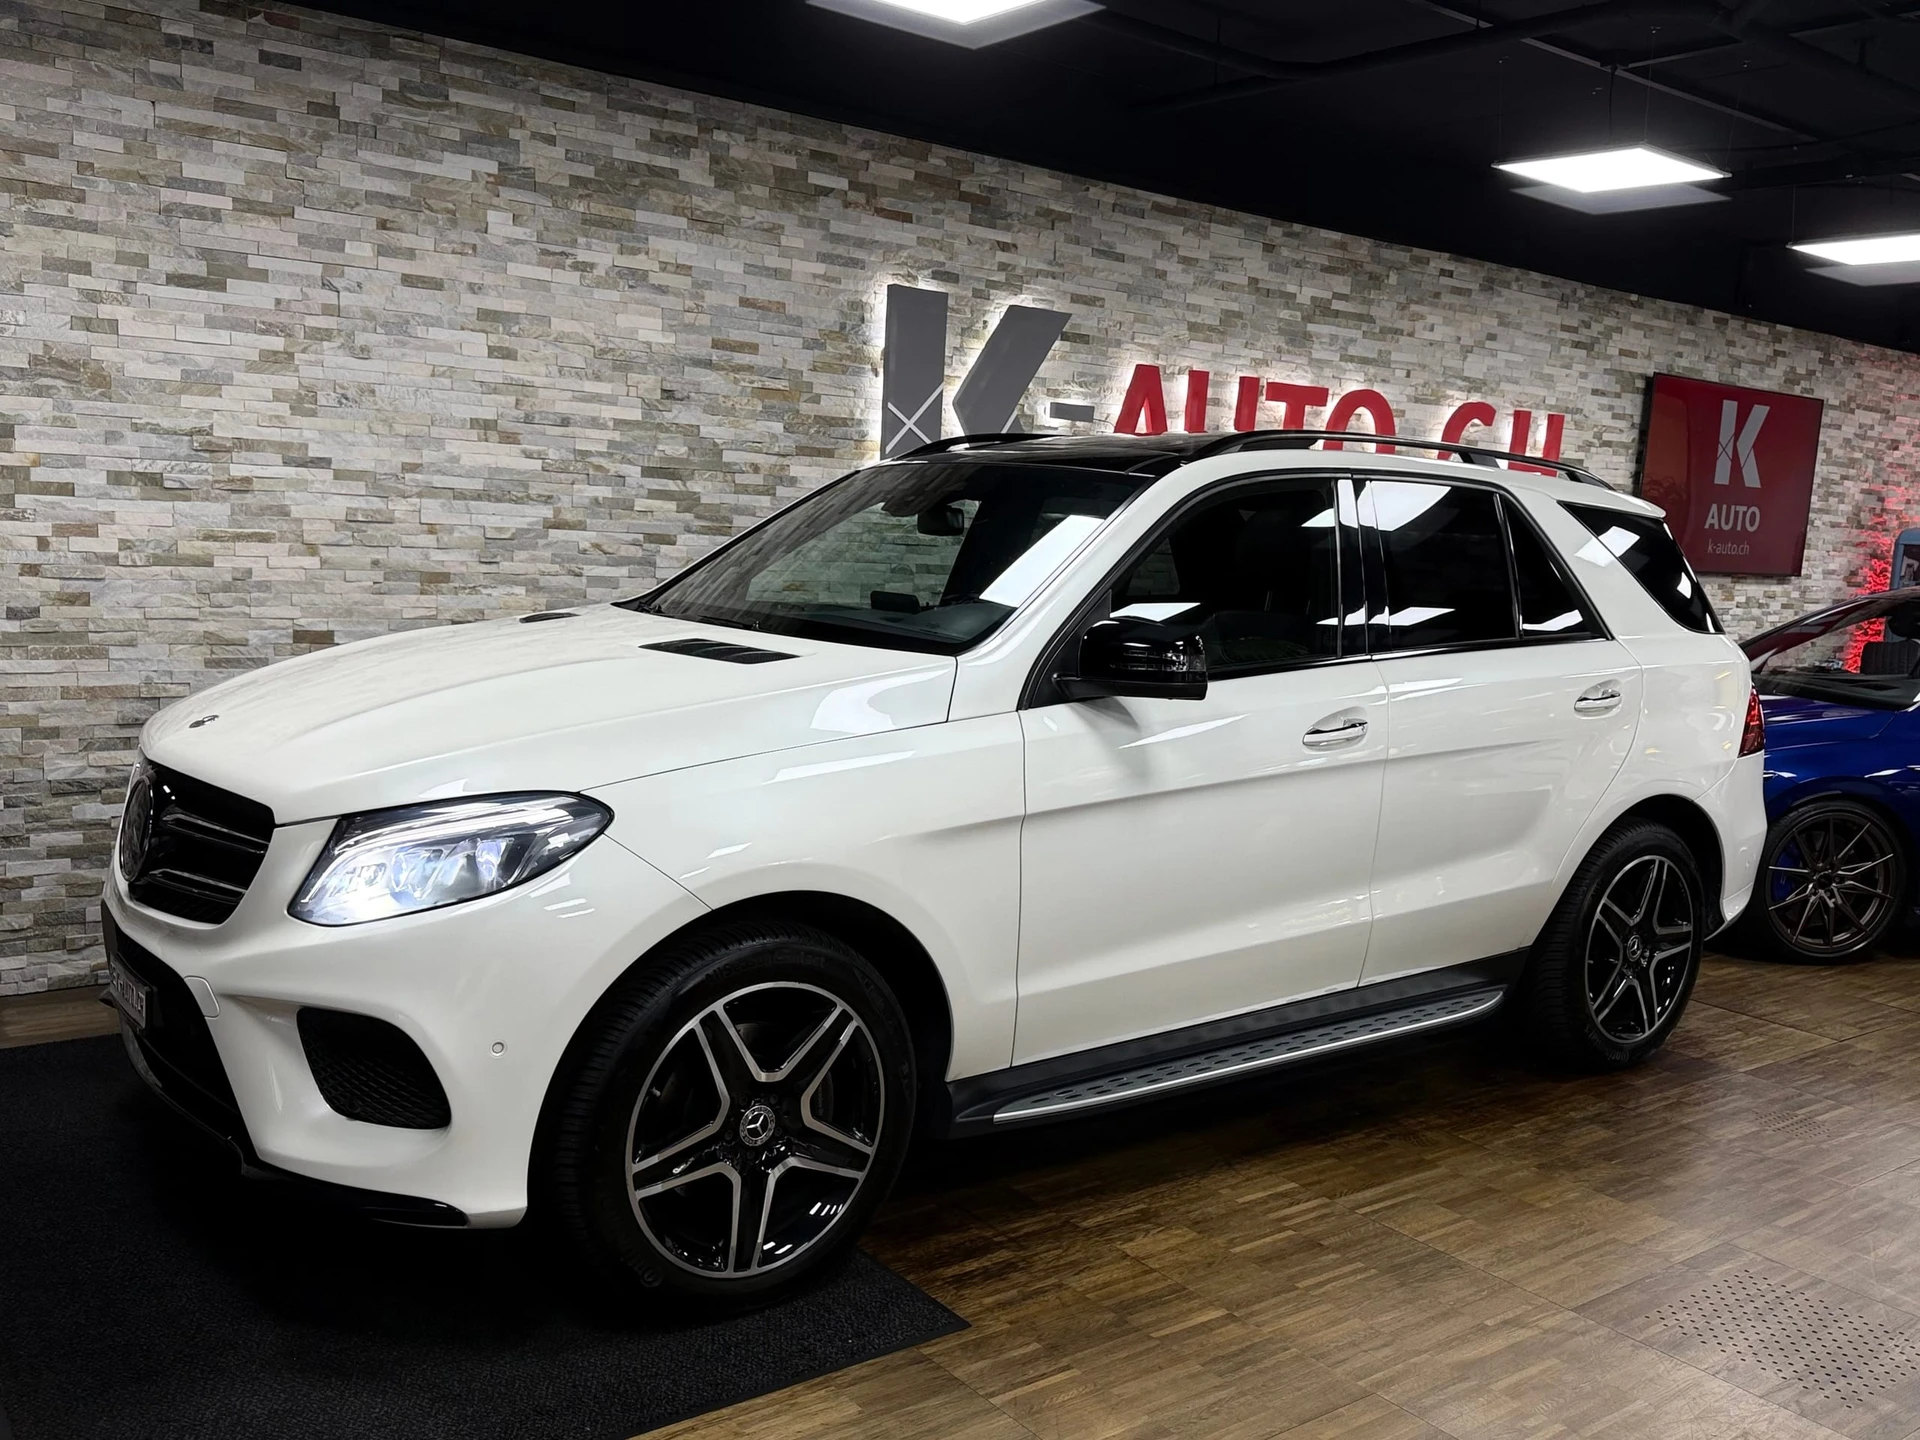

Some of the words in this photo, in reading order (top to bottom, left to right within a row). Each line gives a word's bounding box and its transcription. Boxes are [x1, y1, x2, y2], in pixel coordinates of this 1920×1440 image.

[1714, 399, 1770, 488] K
[1704, 503, 1760, 532] AUTO
[1707, 539, 1750, 556] k-auto.ch
